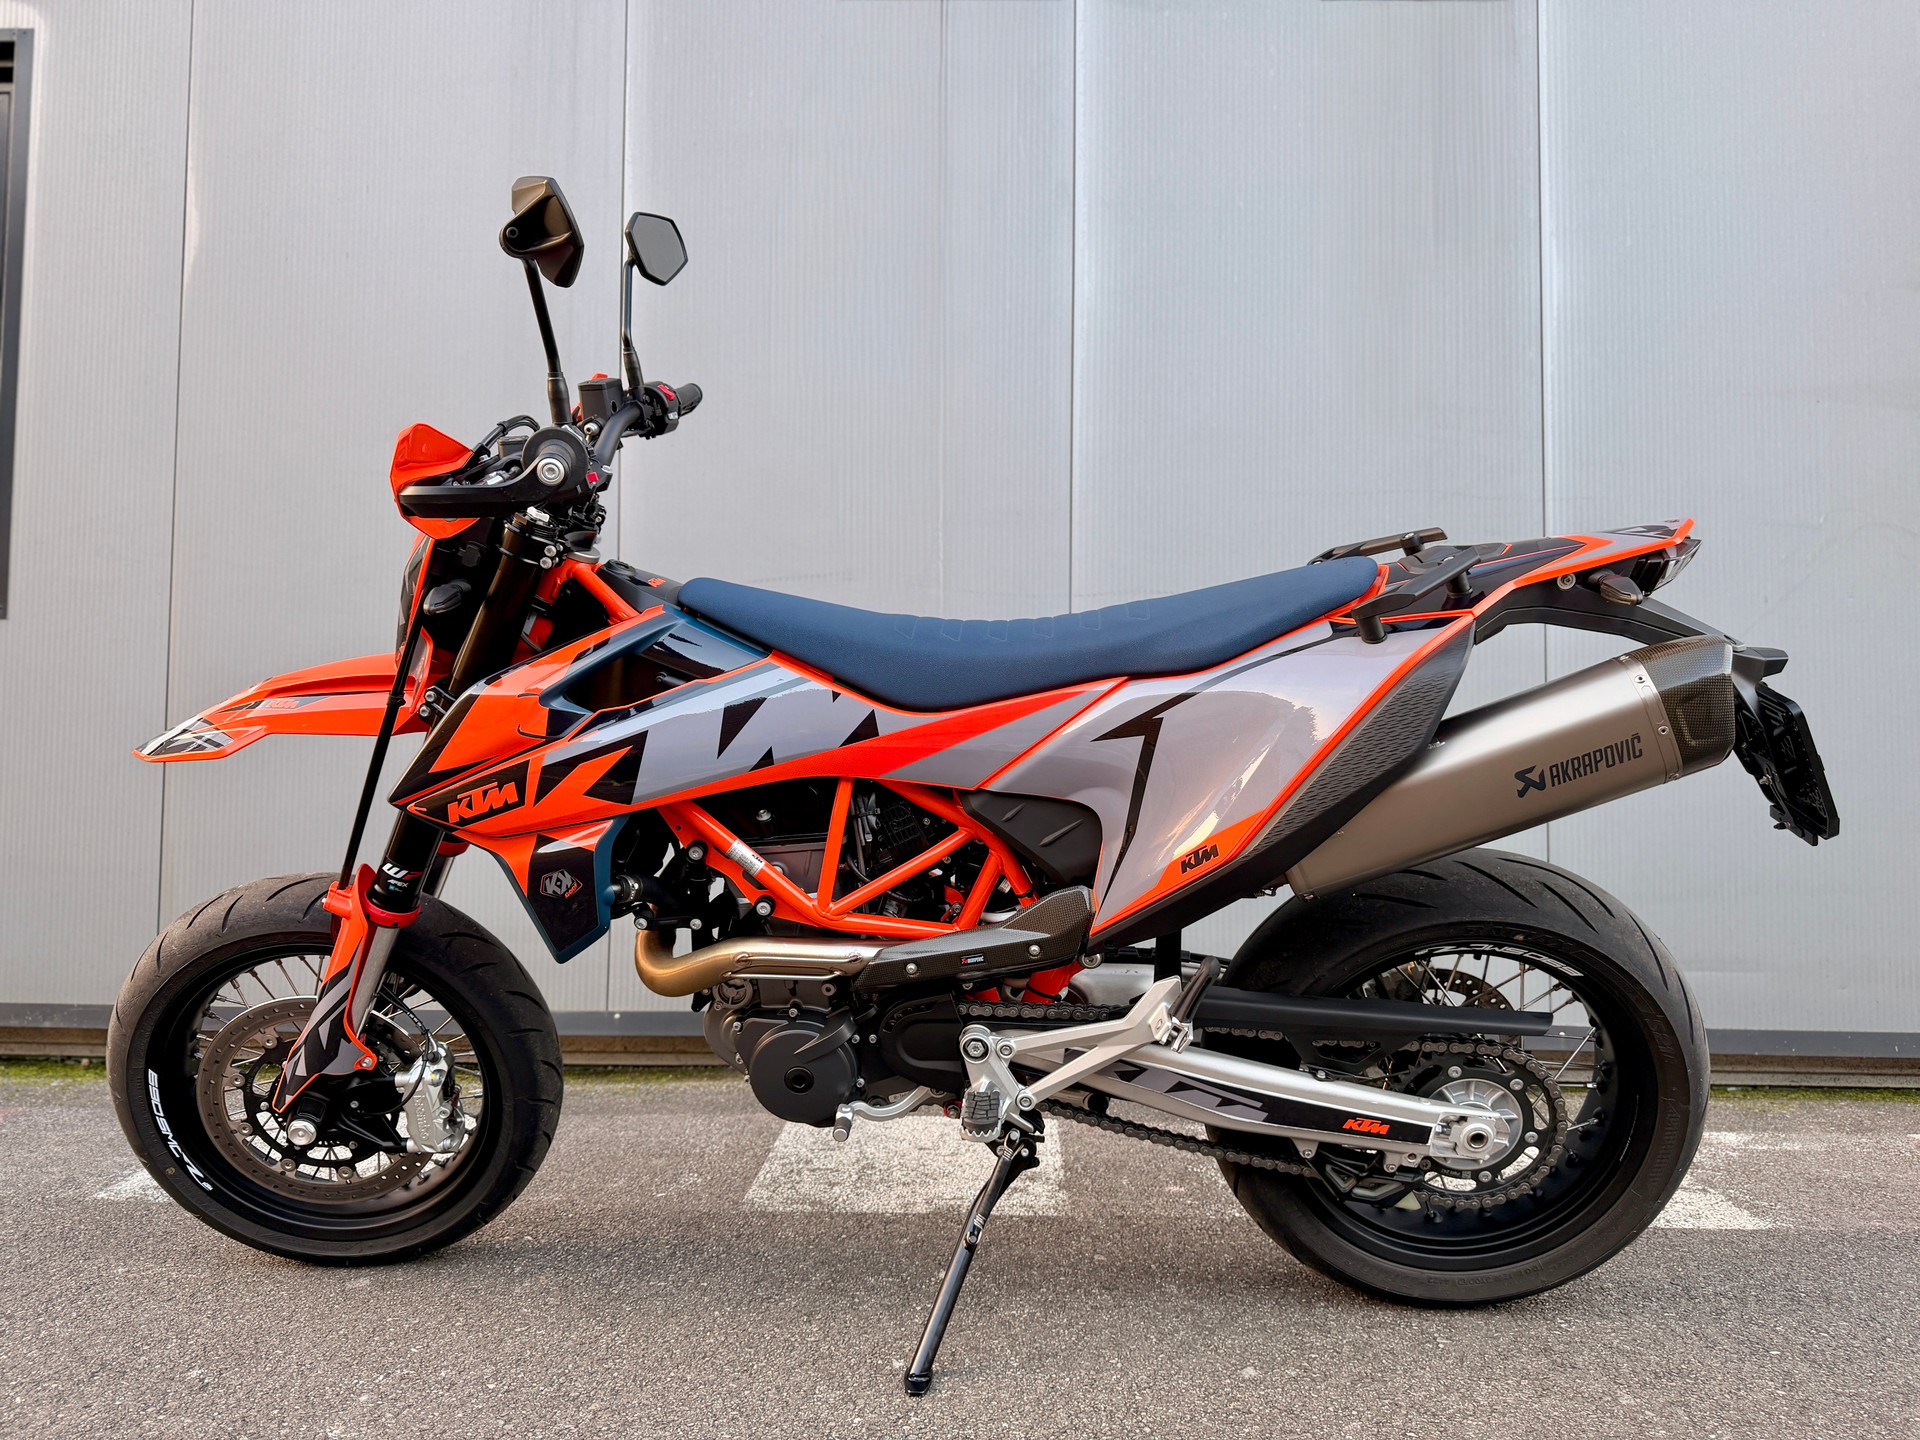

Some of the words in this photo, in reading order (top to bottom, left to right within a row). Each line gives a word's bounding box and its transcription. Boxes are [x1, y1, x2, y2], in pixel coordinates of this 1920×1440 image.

[447, 782, 519, 824] KTM
[382, 862, 424, 881] WP
[1181, 844, 1219, 875] KTM
[1342, 1117, 1391, 1135] KTM
